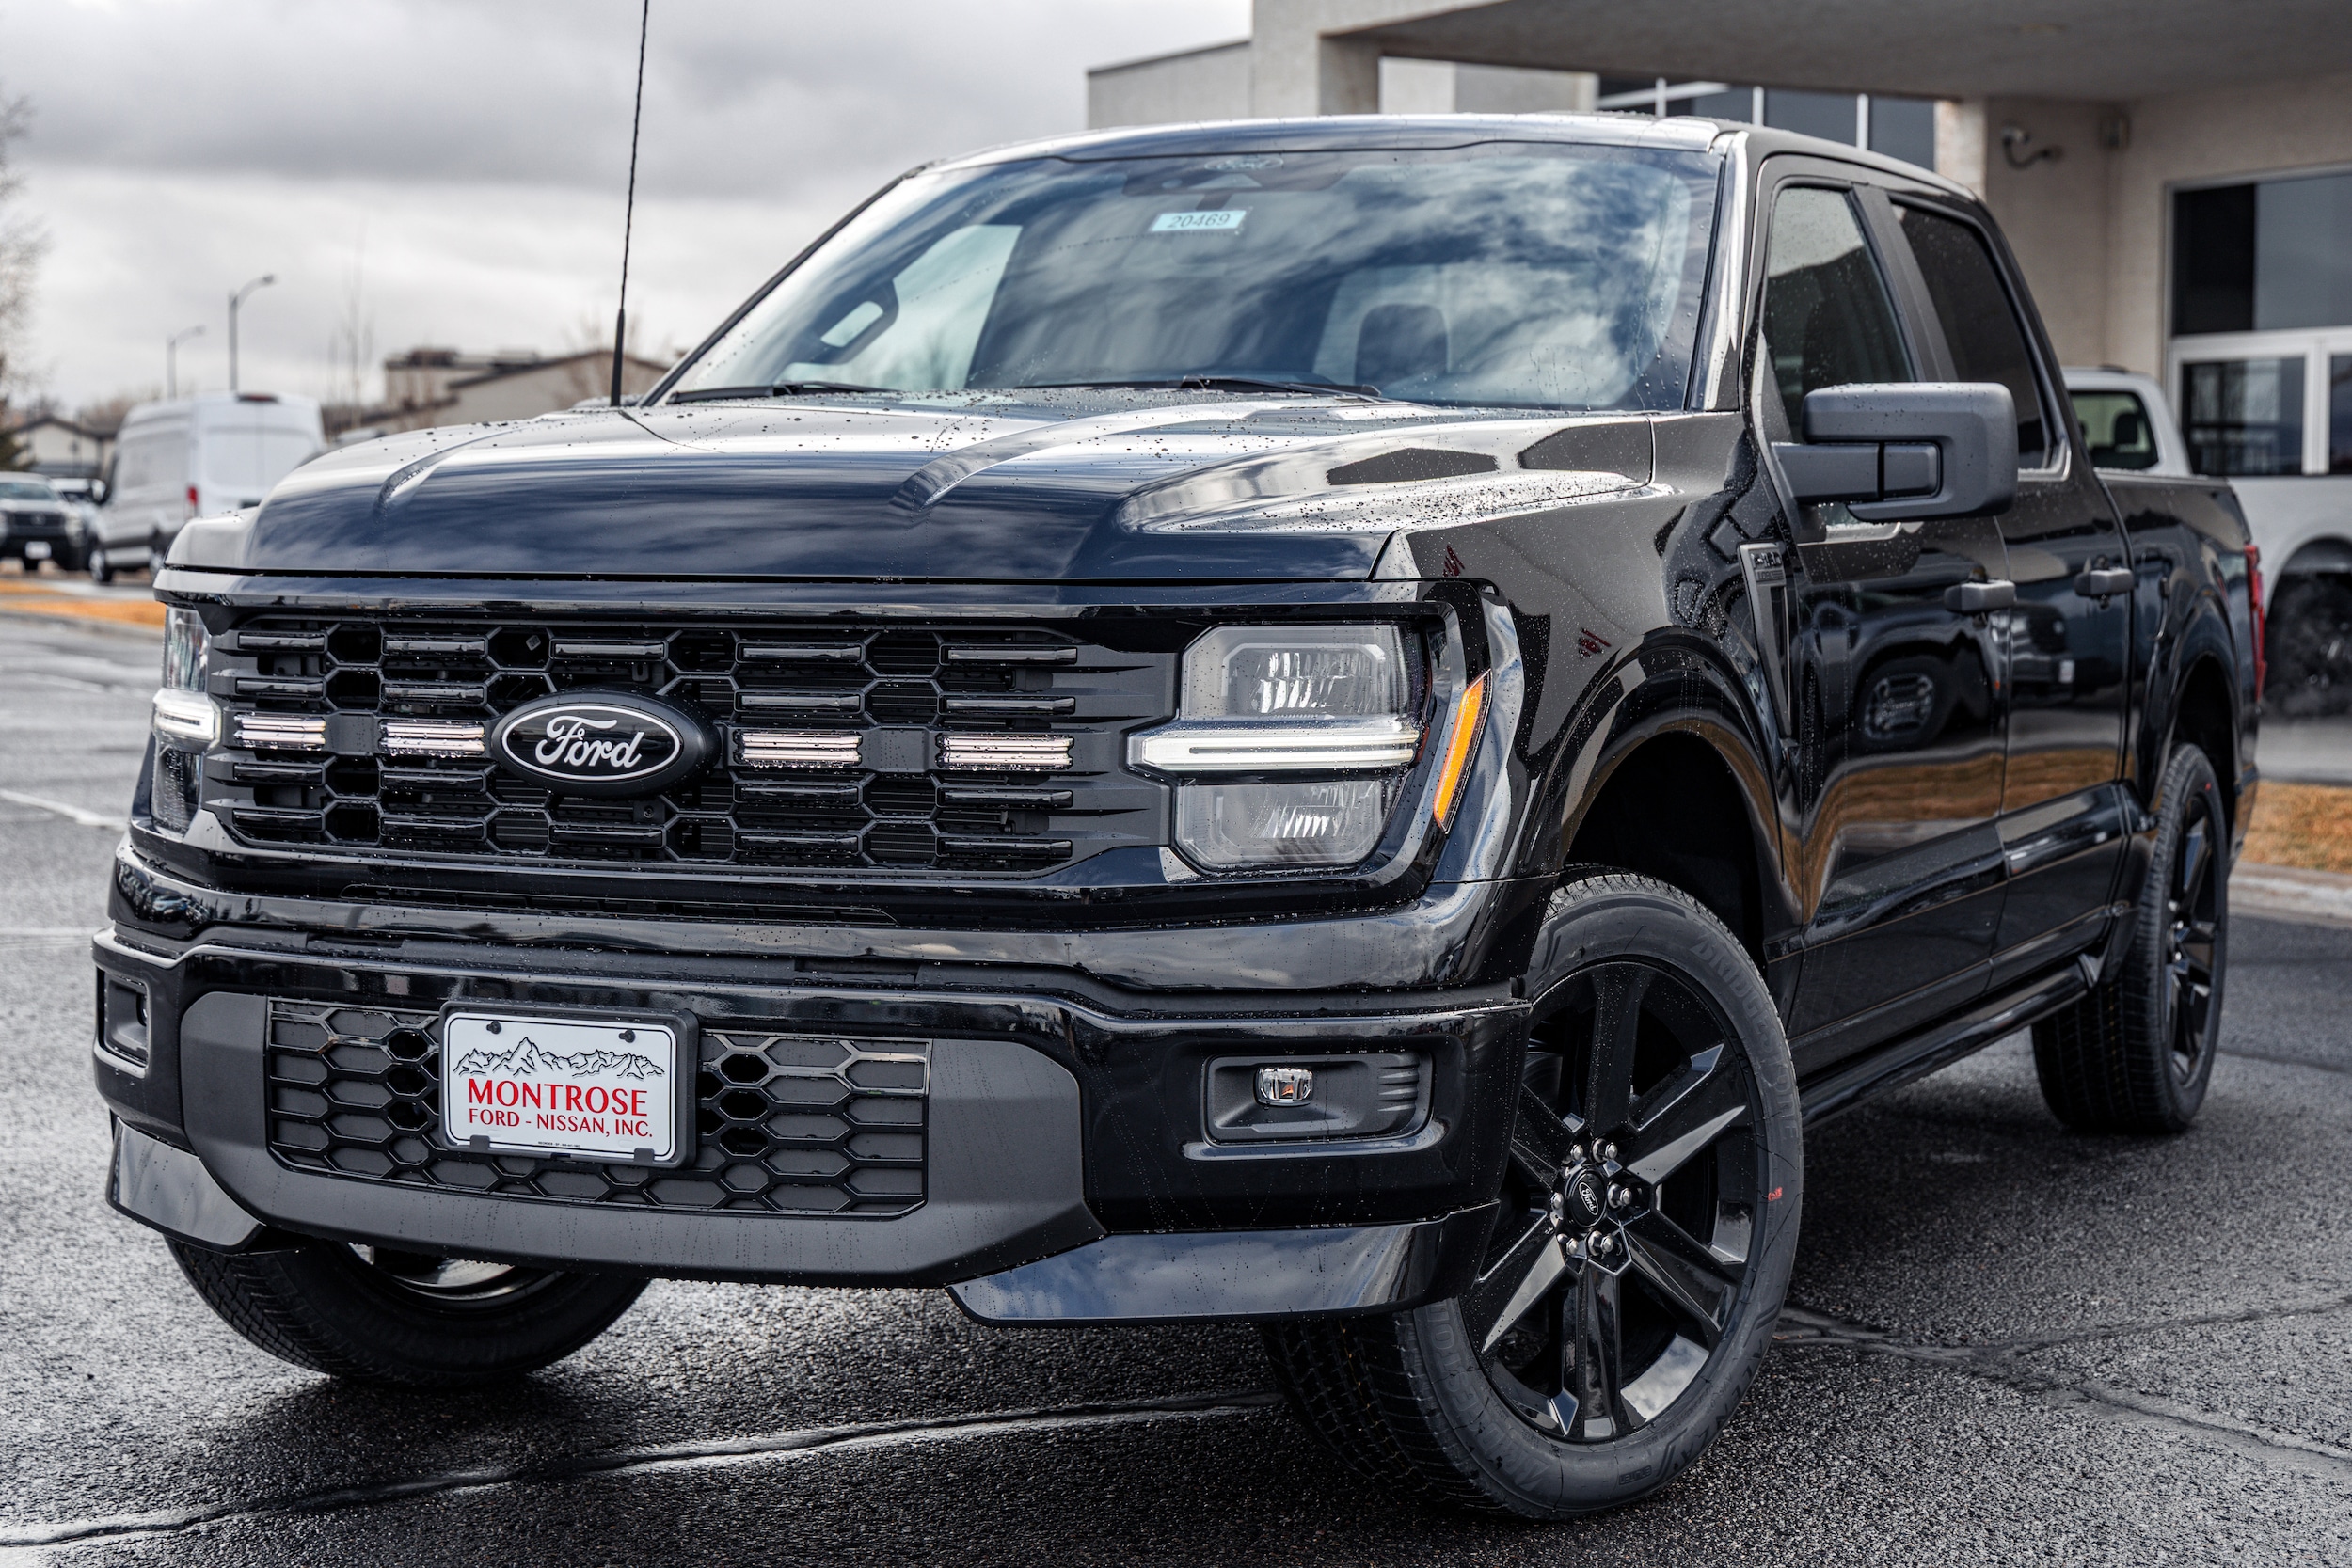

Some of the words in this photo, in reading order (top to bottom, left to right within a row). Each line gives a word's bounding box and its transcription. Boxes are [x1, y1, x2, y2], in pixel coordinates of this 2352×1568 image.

[1167, 214, 1231, 229] 20469
[534, 715, 645, 768] Ford
[1690, 927, 1798, 1140] BRIDGESTONE
[469, 1077, 648, 1117] MONTROSE
[469, 1108, 520, 1127] FORD
[537, 1114, 610, 1136] NISSAN,
[615, 1119, 653, 1138] INC.
[1581, 1188, 1597, 1212] Ford
[1424, 1298, 1550, 1493] BRIDGESTON
